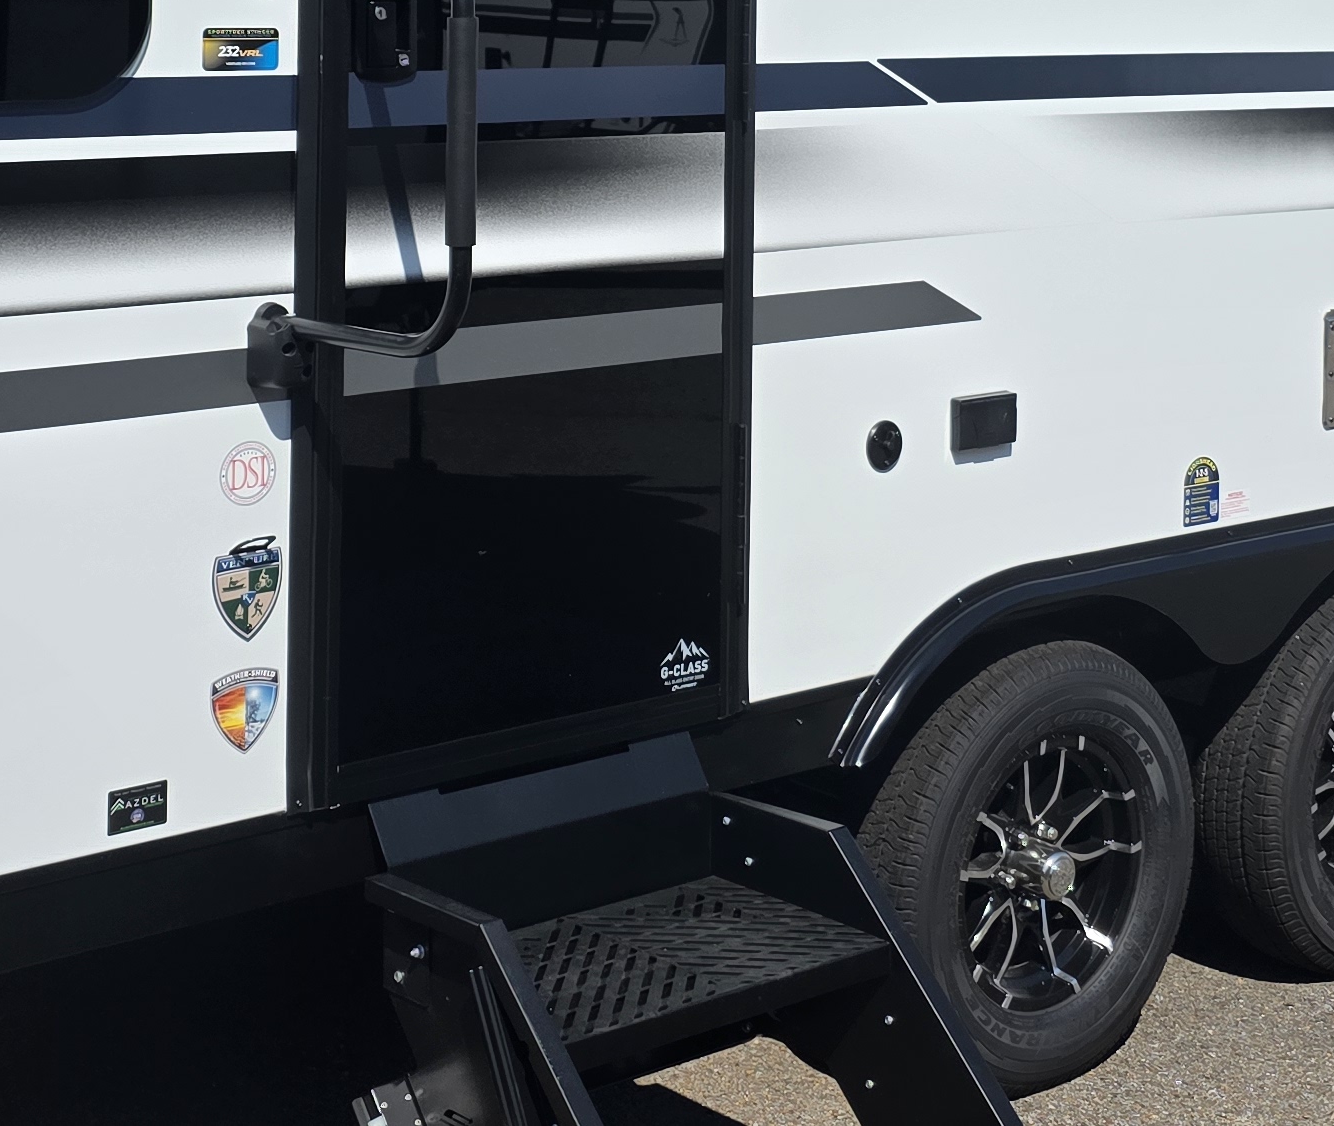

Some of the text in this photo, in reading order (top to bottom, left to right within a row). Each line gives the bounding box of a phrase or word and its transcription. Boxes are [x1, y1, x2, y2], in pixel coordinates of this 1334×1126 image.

[229, 455, 267, 490] DSI
[660, 659, 709, 680] G-CLASS
[125, 794, 164, 809] AZDEL
